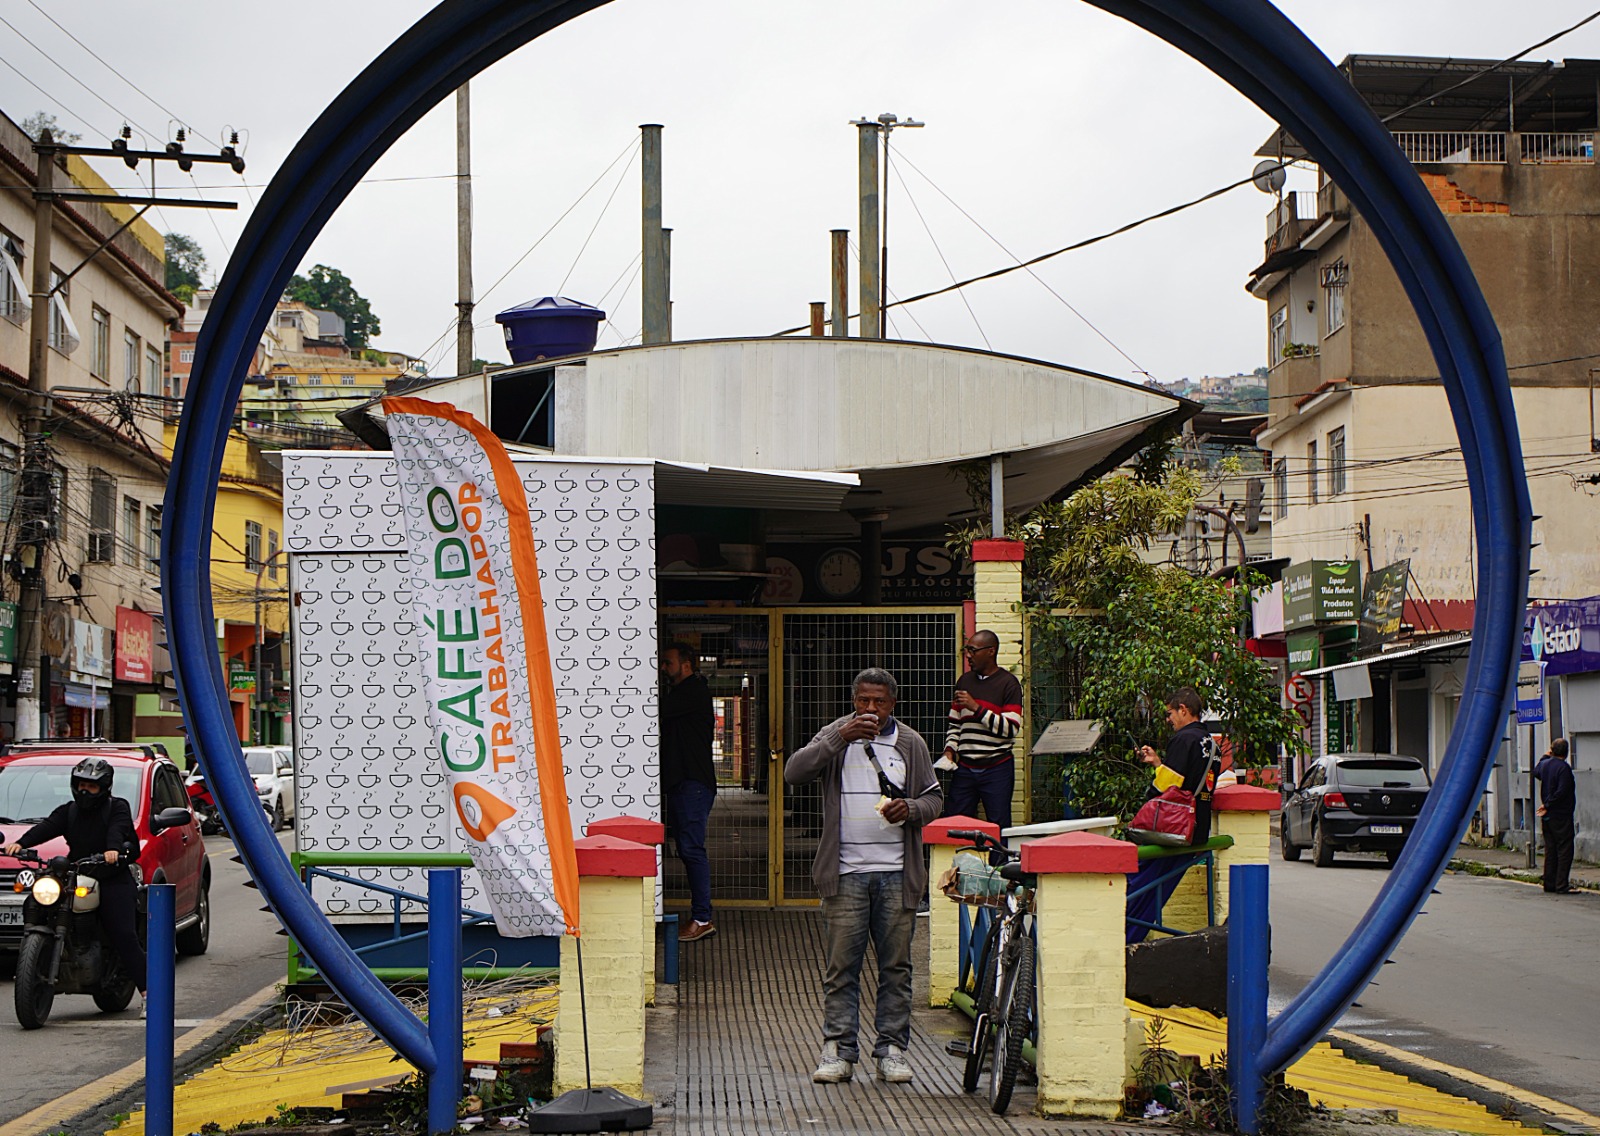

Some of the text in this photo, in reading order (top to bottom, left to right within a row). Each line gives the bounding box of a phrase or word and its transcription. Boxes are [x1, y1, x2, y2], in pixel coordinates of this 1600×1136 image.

[767, 565, 792, 576] OX
[1334, 586, 1355, 594] Natural
[1323, 600, 1354, 608] Produtos
[1326, 609, 1354, 618] naturais
[423, 486, 486, 773] CAFÉ DO
[458, 480, 517, 773] TRABALHADOR
[1544, 622, 1581, 654] Estácio
[1517, 707, 1543, 718] ÔNIBUS
